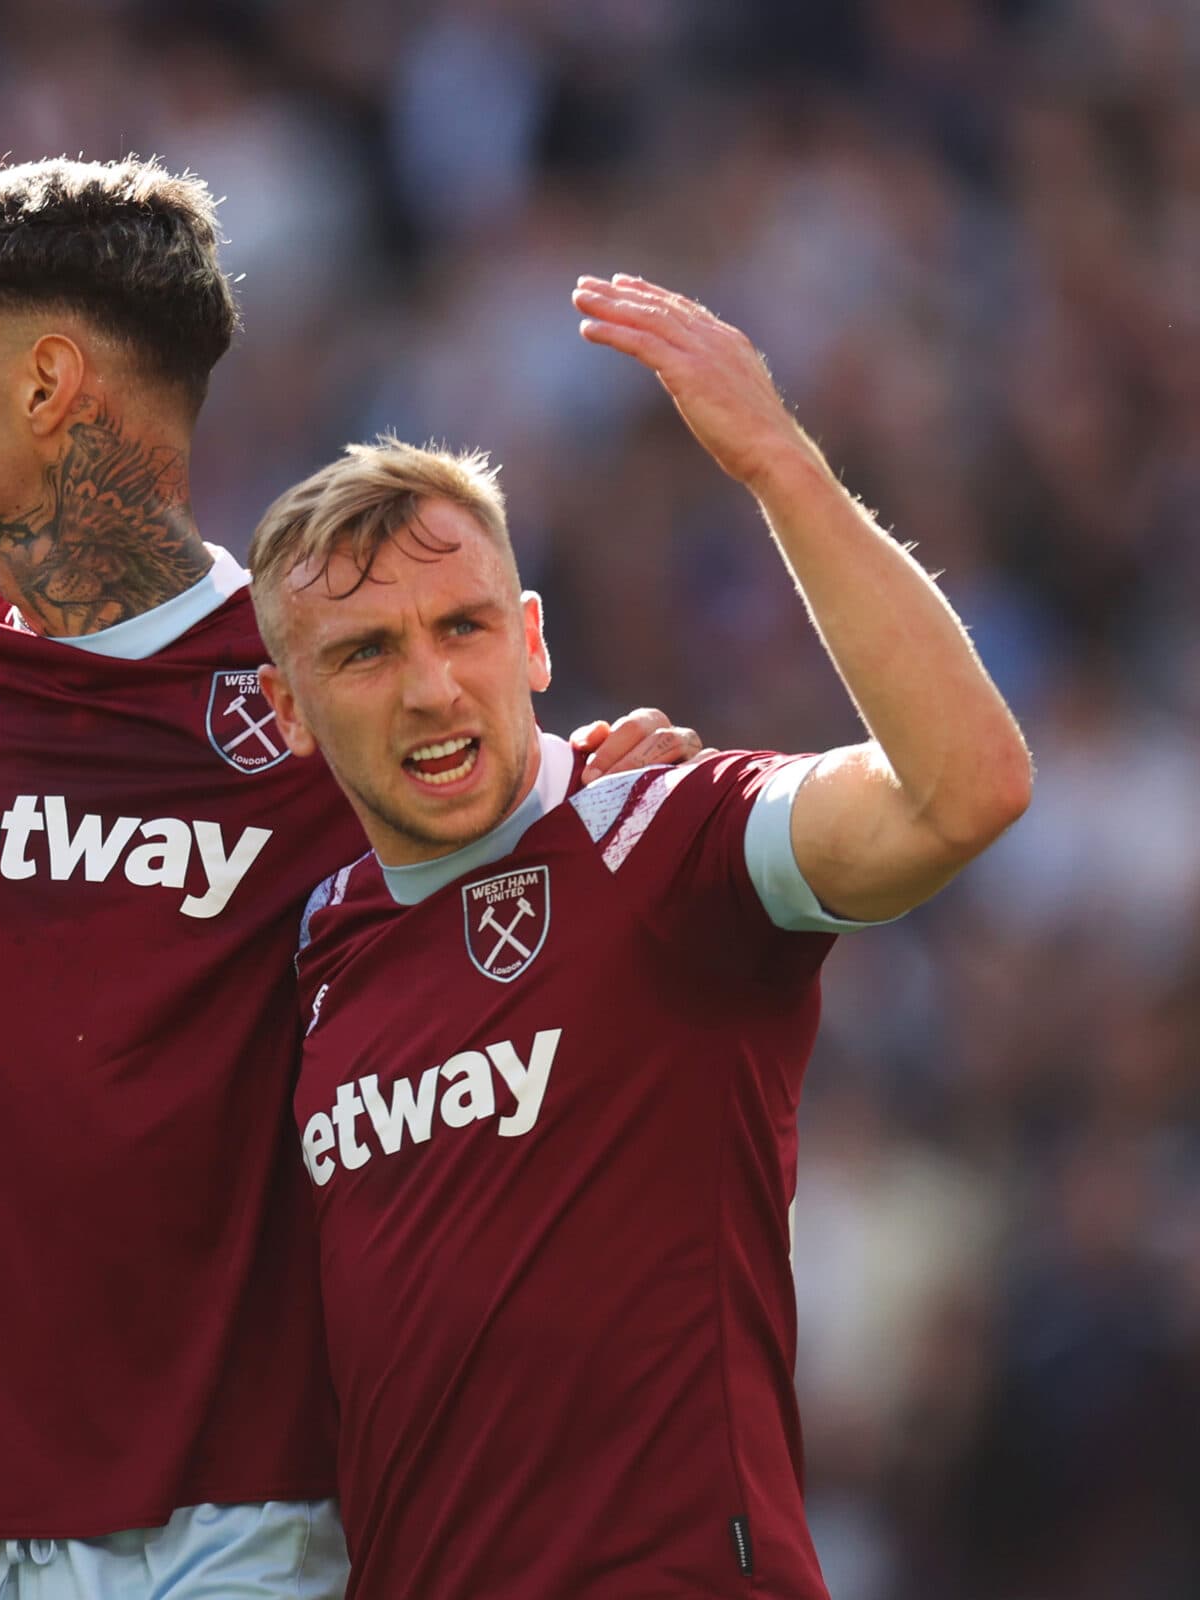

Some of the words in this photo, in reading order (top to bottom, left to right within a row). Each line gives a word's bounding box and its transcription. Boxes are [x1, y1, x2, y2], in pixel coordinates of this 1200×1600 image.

[239, 685, 260, 694] UNI
[232, 753, 267, 765] LONDON
[471, 879, 506, 900] WEST
[507, 873, 539, 888] HAM
[486, 887, 525, 904] UNITED
[492, 960, 522, 975] LONDON
[302, 1028, 562, 1186] etway
